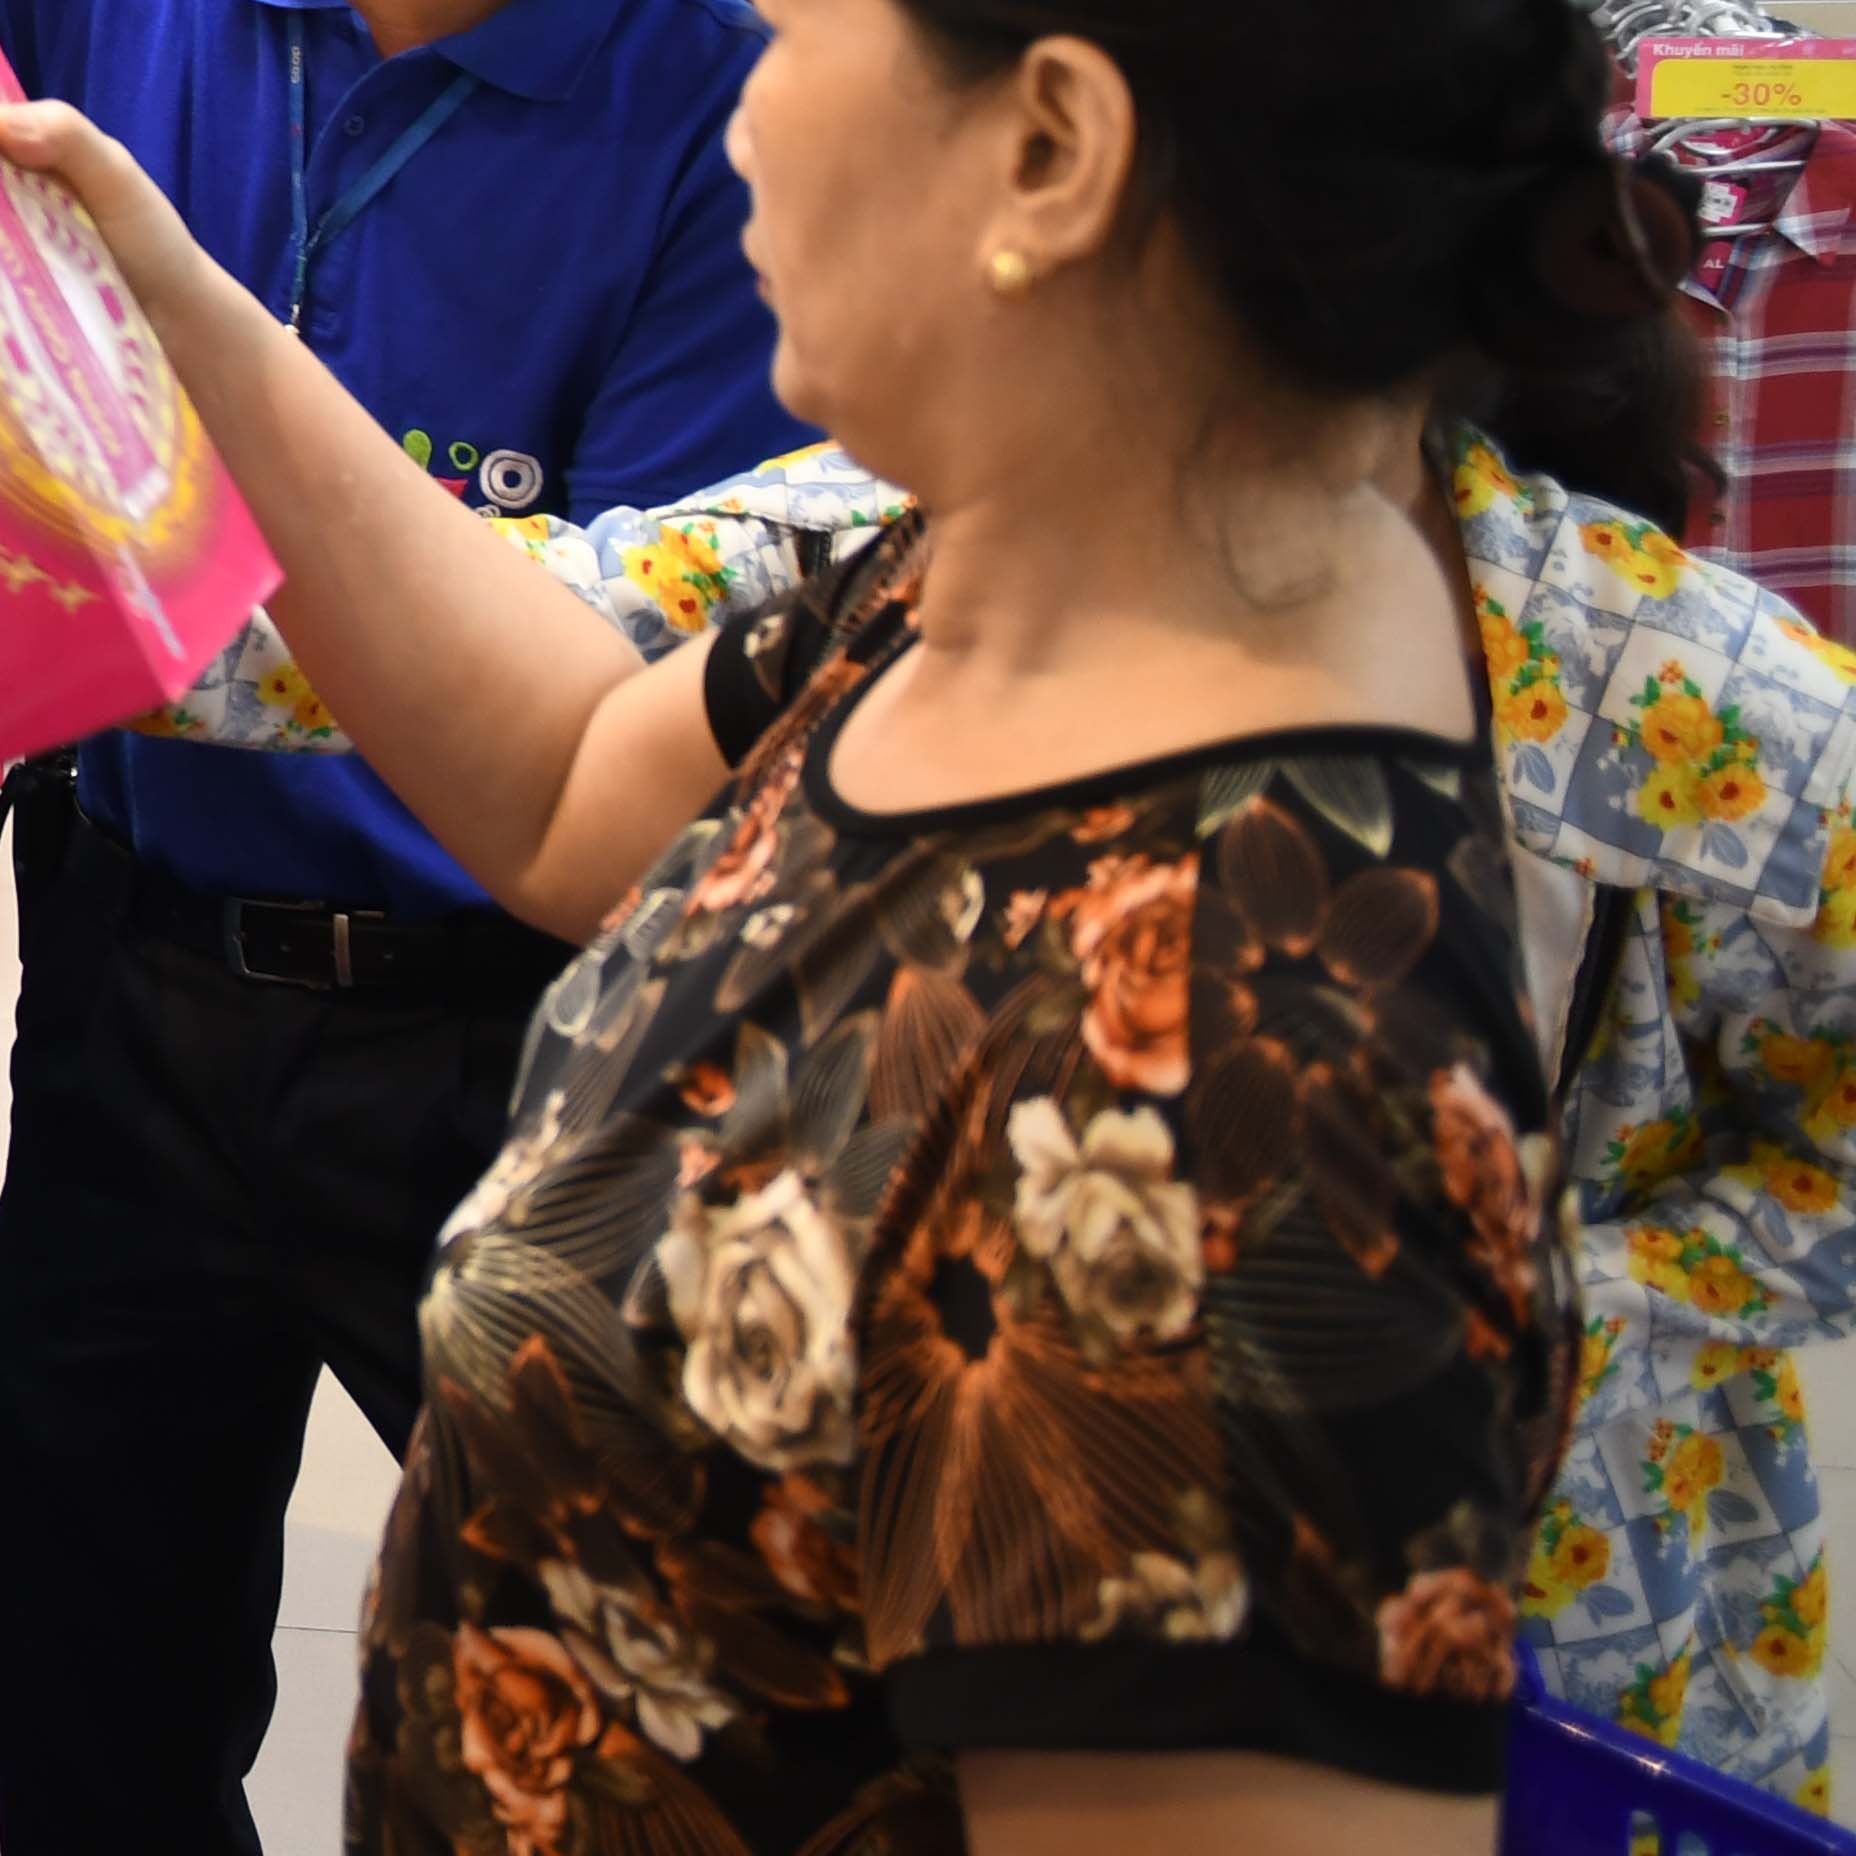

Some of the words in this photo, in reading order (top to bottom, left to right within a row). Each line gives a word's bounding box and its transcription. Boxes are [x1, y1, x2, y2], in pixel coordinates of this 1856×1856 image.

[1652, 42, 1713, 59] Khuyến
[1715, 43, 1745, 57] mãi
[1720, 81, 1802, 107] -30%
